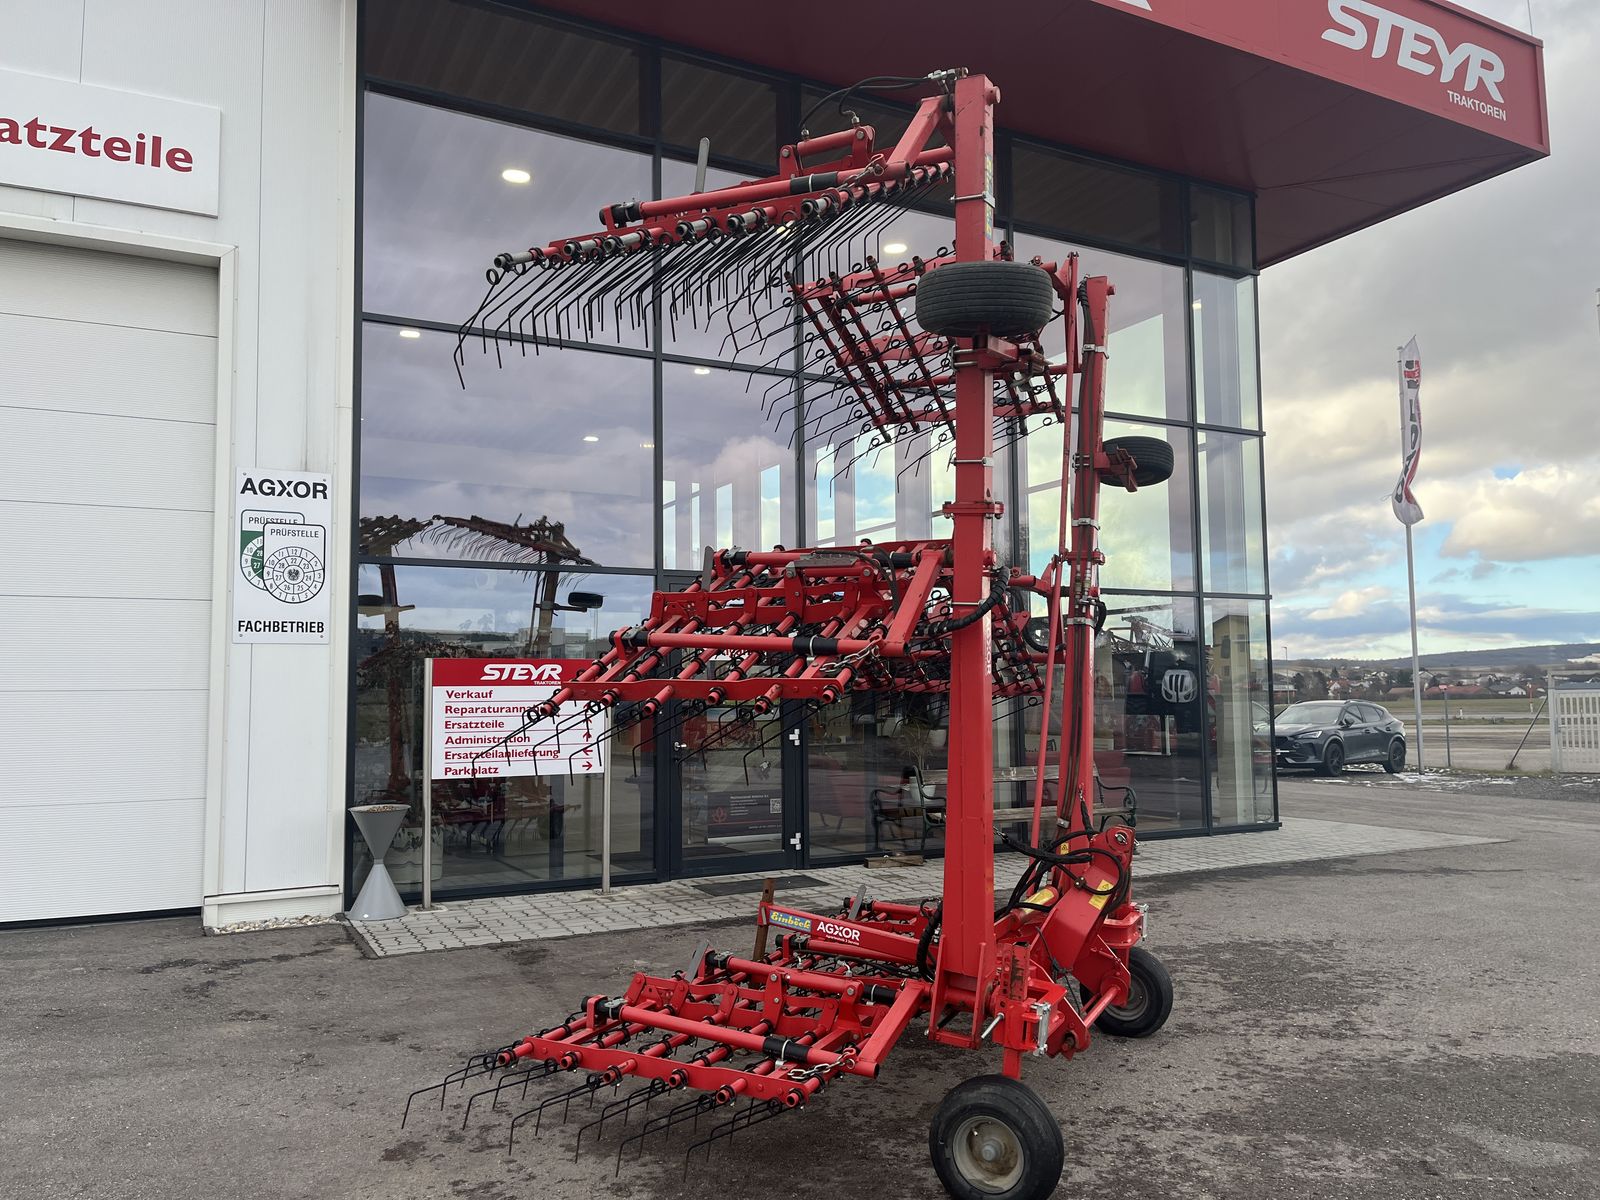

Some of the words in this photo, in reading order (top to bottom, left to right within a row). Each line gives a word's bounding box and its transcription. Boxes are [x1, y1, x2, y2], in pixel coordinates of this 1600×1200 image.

[1321, 0, 1506, 104] STEYR
[1447, 90, 1507, 122] TRAKTOREN
[0, 116, 193, 172] atzteile
[240, 477, 328, 500] AGXOR
[270, 528, 319, 538] PRÜFSTELLE
[237, 620, 325, 634] FACHBETRIEB
[480, 664, 562, 680] STEYR
[446, 689, 494, 699] Verkauf
[444, 720, 505, 730] Ersatzteile
[444, 748, 560, 760] Ersatzteilanlieferung
[444, 766, 500, 776] Parkplatz
[817, 921, 860, 941] AGXOR
